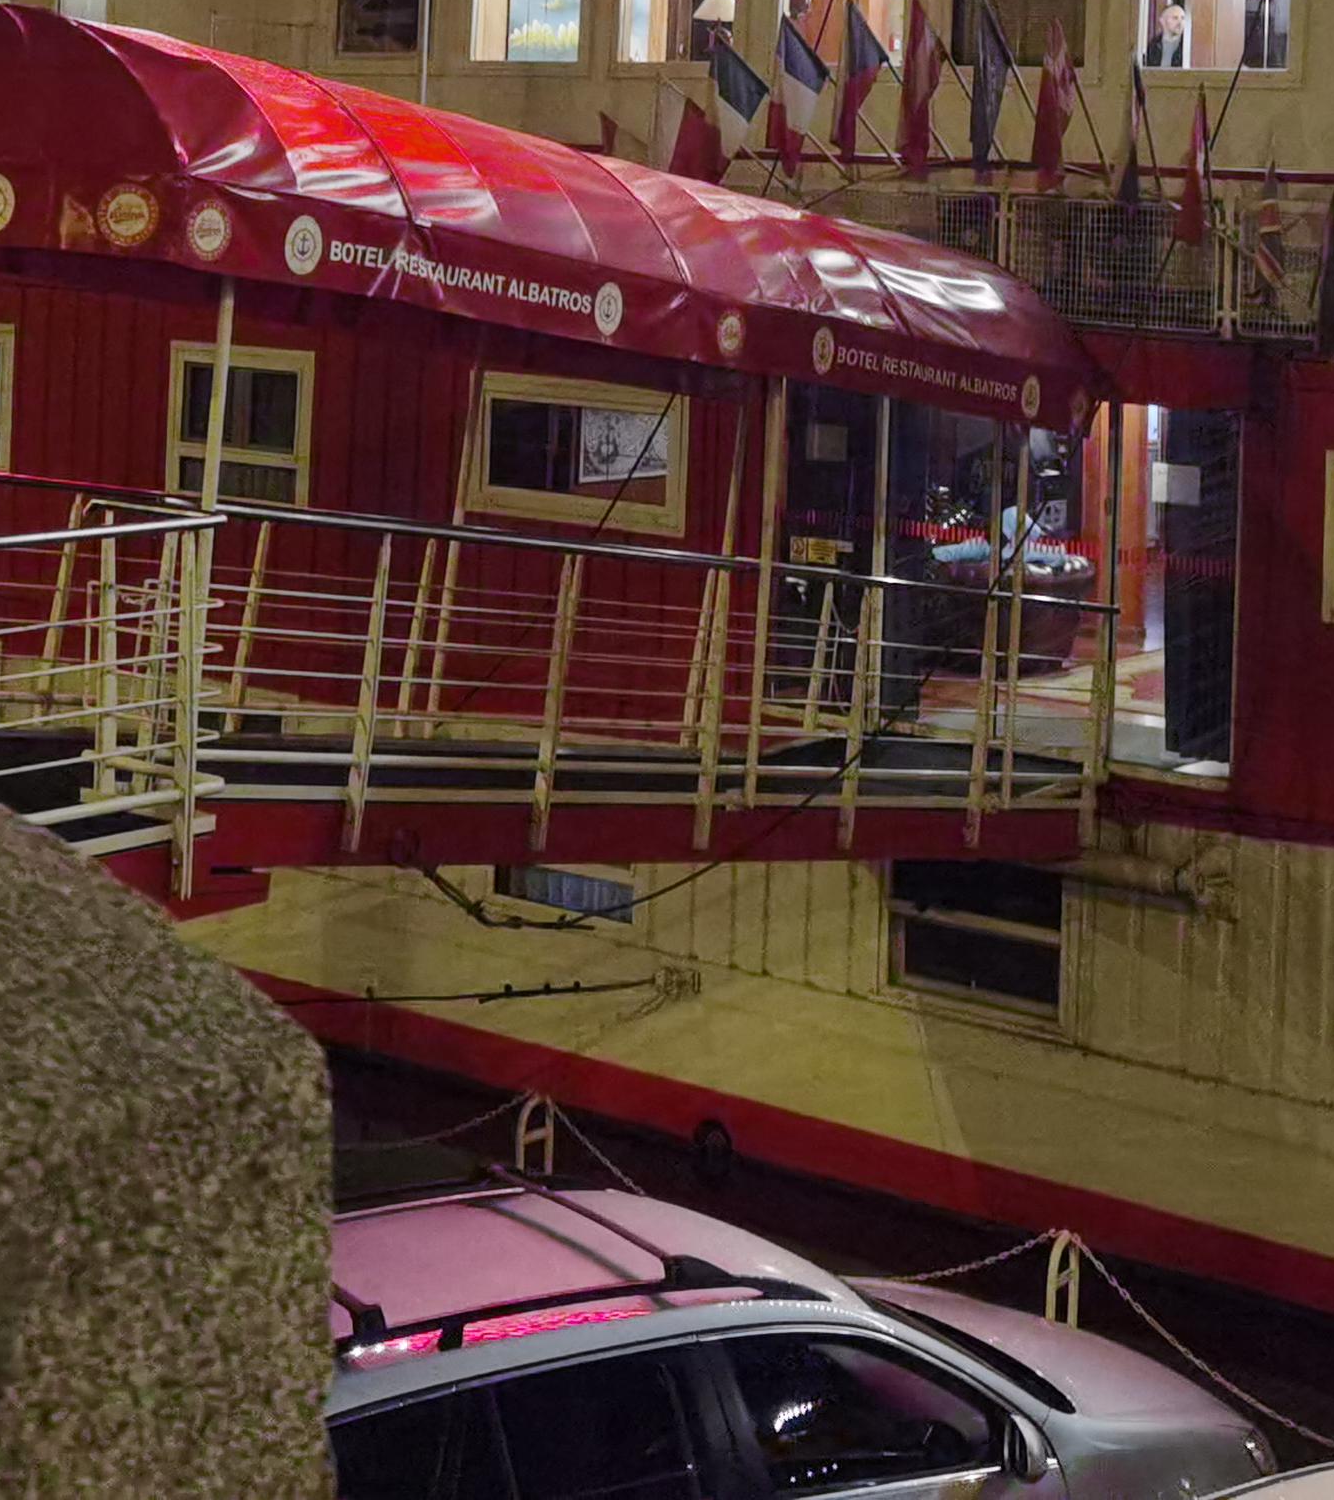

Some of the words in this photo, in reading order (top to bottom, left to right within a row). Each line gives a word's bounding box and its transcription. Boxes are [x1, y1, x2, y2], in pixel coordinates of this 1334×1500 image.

[329, 240, 387, 269] BOTEL
[395, 251, 506, 296] RESTAURANT
[508, 278, 593, 315] ALBATROS
[836, 345, 879, 372] BOTEL
[882, 355, 958, 389] RESTAURANT
[960, 373, 1017, 401] ALBATROS
